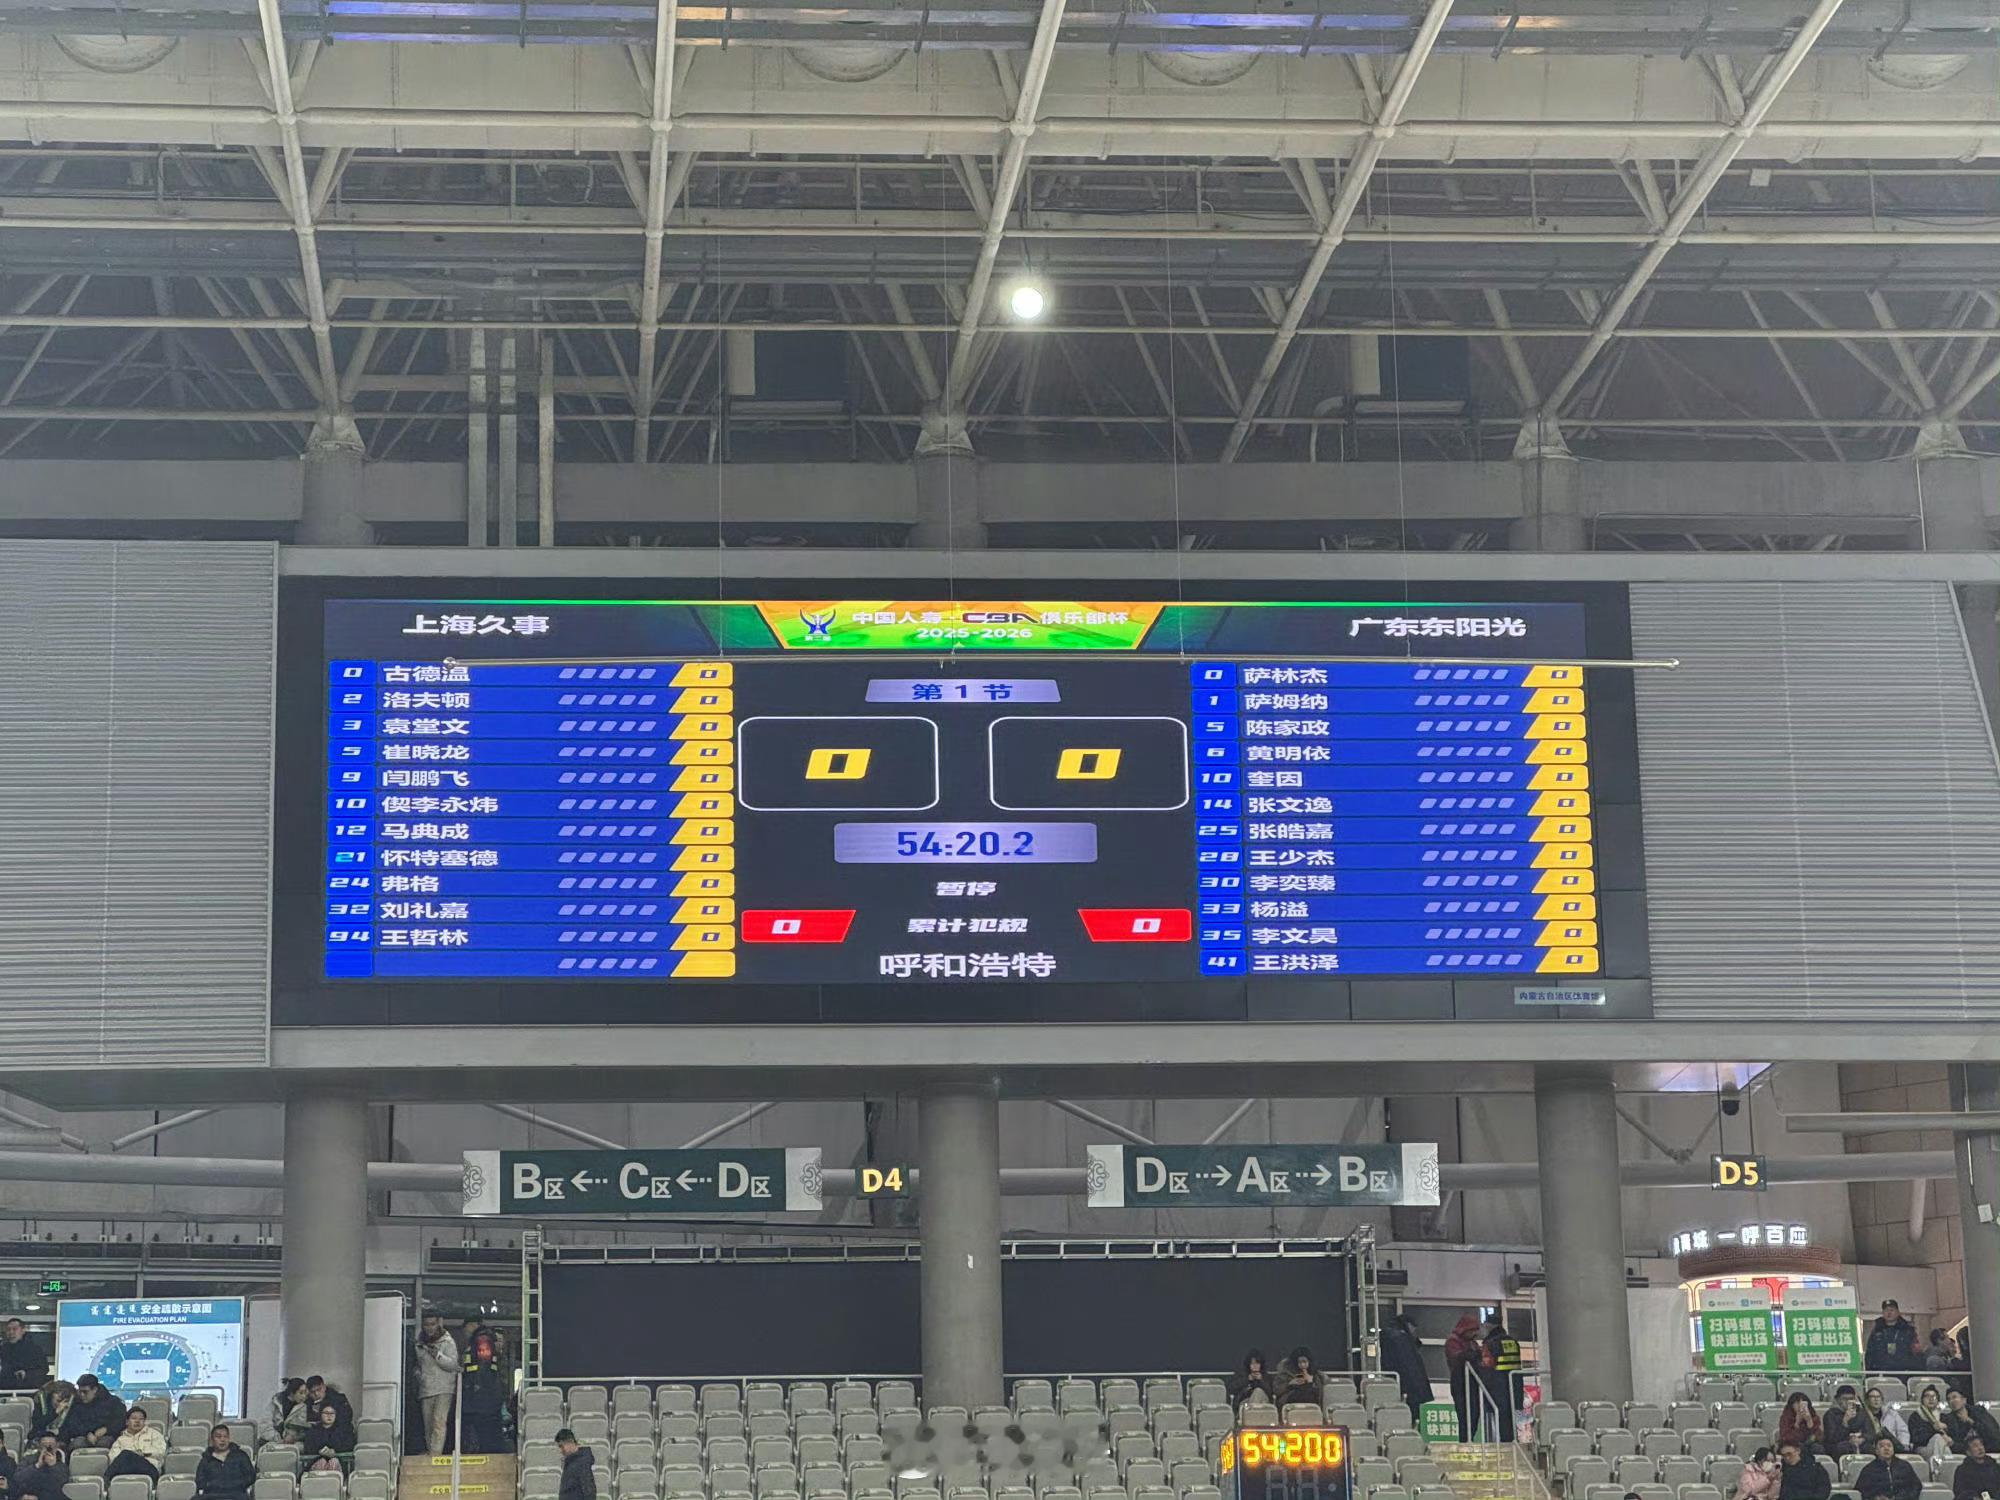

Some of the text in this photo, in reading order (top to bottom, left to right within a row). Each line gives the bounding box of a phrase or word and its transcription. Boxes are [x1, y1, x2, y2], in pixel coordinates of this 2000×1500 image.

[403, 615, 549, 635] 上海久事
[1349, 617, 1526, 637] 广东东阳光
[915, 628, 1033, 639] 2025-2026
[343, 667, 718, 682] 0 古德温 0
[1204, 668, 1568, 684] 0 萨林杰 0
[342, 692, 719, 708] 2 洛夫顿 0
[1210, 694, 1570, 709] 1 萨姆纳 0
[342, 718, 719, 734] 3 袁堂文 0
[1207, 720, 1571, 736] 5 陈家政 0
[342, 745, 719, 759] 5 崔晓龙 0
[1207, 746, 1572, 760] 6 黄明依 0
[805, 749, 871, 779] 0
[1056, 749, 1122, 779] 0
[342, 770, 719, 786] 9 闫鹏飞 0
[1202, 771, 1574, 787] 10 奎因 0
[335, 798, 367, 809] 10
[700, 800, 720, 810] 0
[1203, 797, 1575, 813] 14 张文逸 0
[335, 823, 720, 839] 12 马典成 0
[1198, 823, 1577, 839] 25 张皓嘉 0
[897, 831, 1034, 858] 54:20.2
[335, 850, 720, 866] 21 怀特塞德 0
[1199, 850, 1578, 865] 28 王少杰 0
[329, 876, 720, 892] 24 弗格 0
[937, 882, 997, 896] 暂停
[1199, 875, 1579, 891] 30 李奕臻 0
[328, 902, 721, 919] 32 刘礼嘉 0
[1201, 902, 1581, 917] 33 杨溢 0
[771, 919, 801, 935] 0
[908, 918, 1028, 932] 累计犯规
[1131, 918, 1161, 934] 0
[328, 929, 721, 945] 94 王哲林 0
[1202, 928, 1582, 944] 35 李文昊 0
[880, 952, 1056, 977] 呼和浩特
[1208, 954, 1584, 970] 41 王洪泽 0
[513, 1162, 771, 1199] B区 C区 D区
[862, 1168, 903, 1193] D4
[1136, 1156, 1388, 1193] D区 A区 B区
[1719, 1161, 1759, 1185] D5
[140, 1303, 212, 1315] 安全疏散示意图
[127, 1316, 168, 1324] EVACUATION
